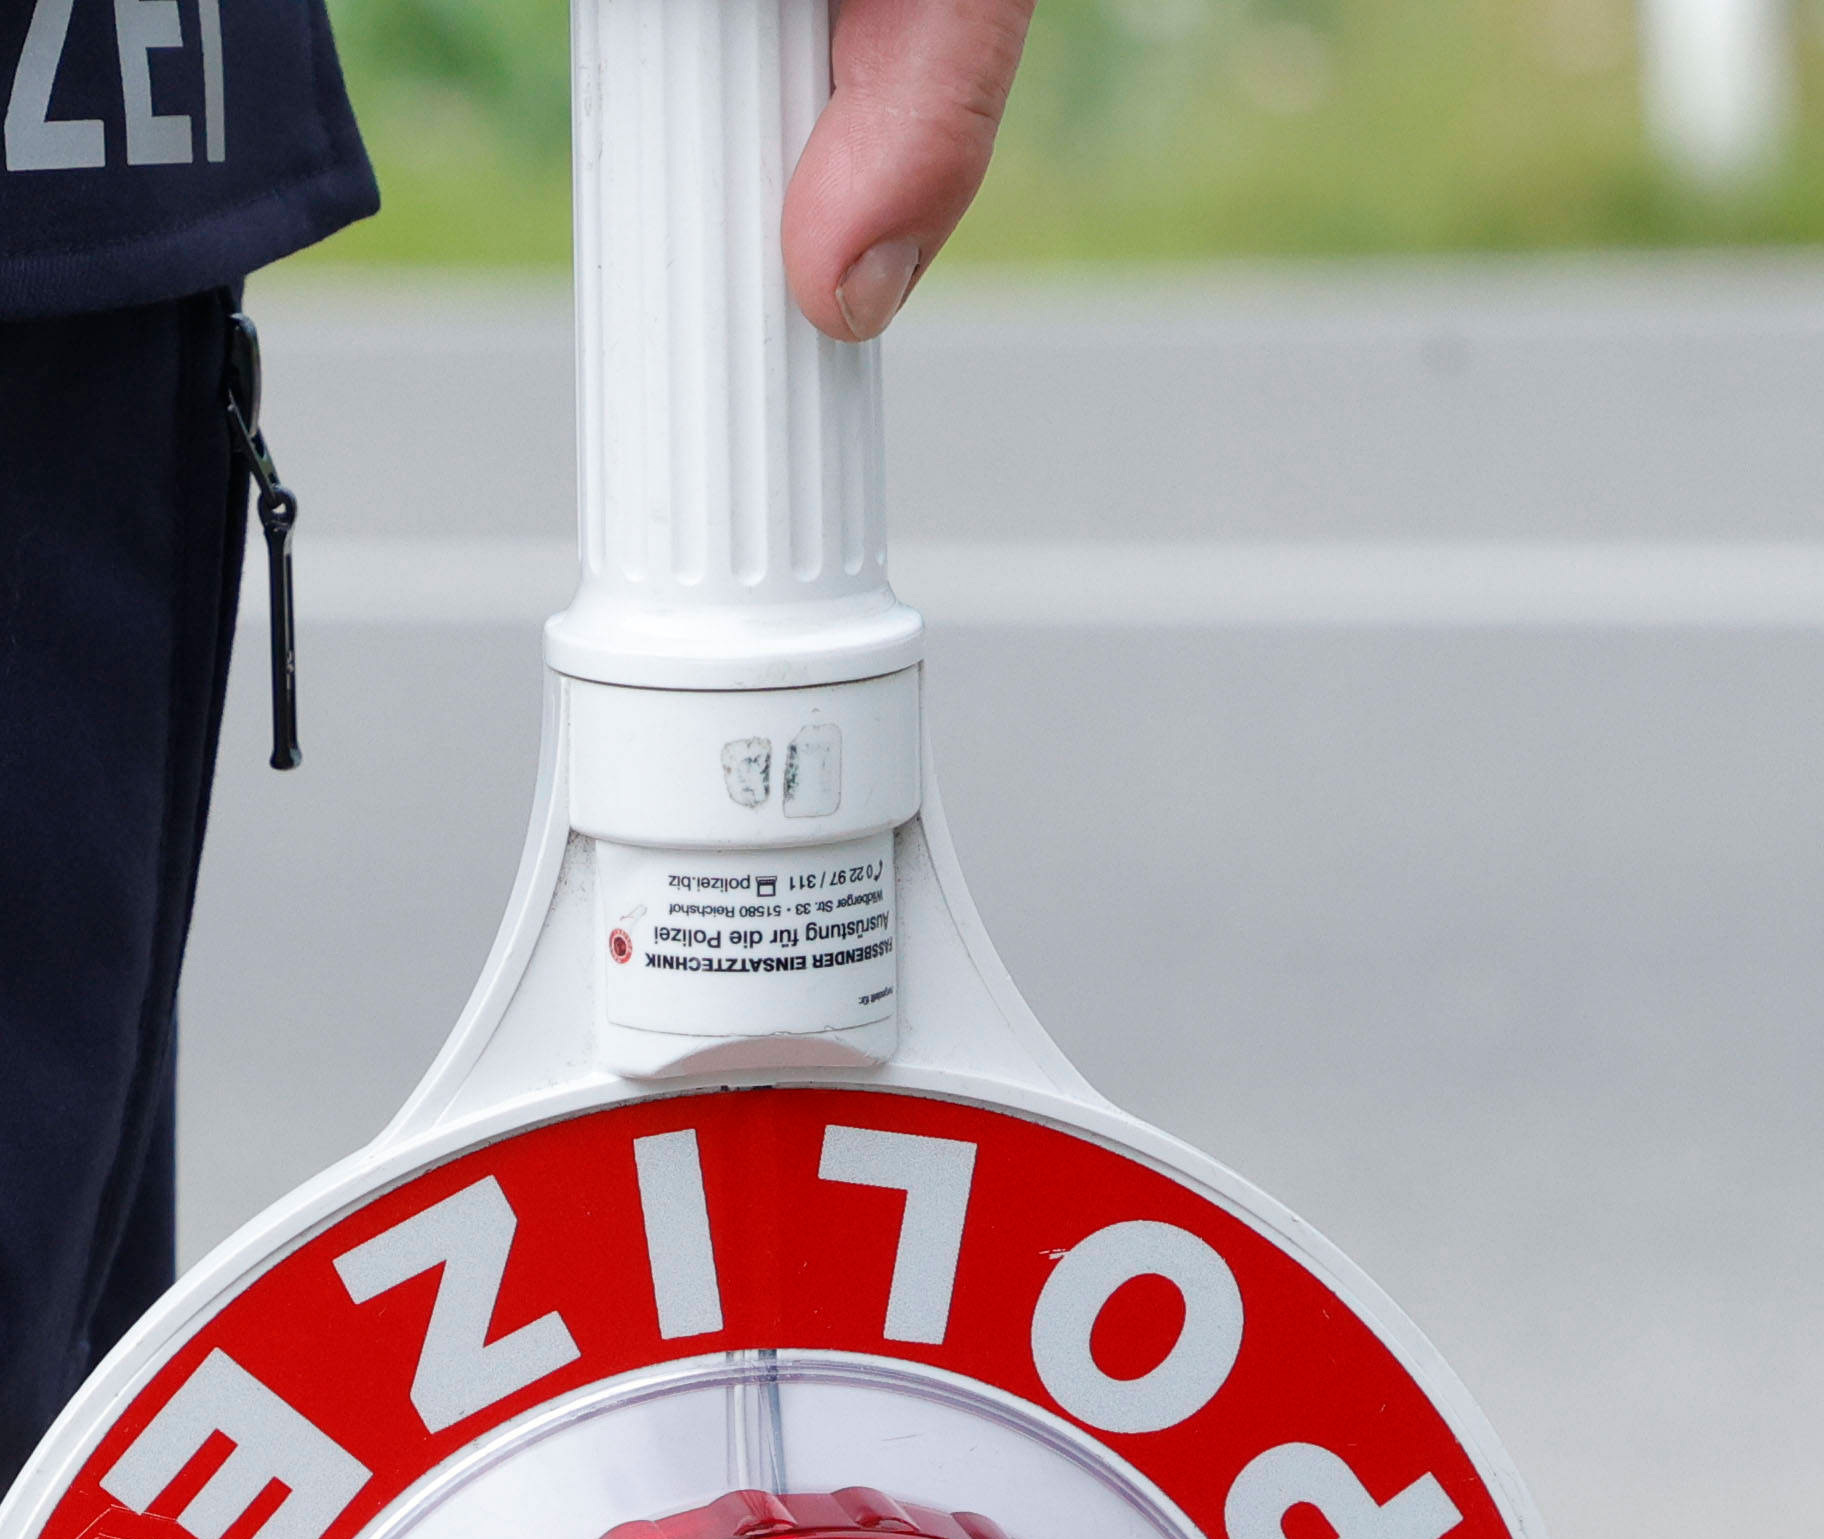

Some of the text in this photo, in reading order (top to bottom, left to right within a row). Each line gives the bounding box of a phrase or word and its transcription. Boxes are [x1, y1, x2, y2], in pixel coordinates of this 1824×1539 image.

[668, 875, 750, 892] polizei.biz
[789, 874, 816, 890] 311
[830, 870, 846, 886] 97
[669, 904, 735, 917] Reichshof
[739, 905, 782, 917] 51580
[796, 903, 811, 915] 33
[815, 900, 833, 912] Str.
[806, 911, 889, 942] Ausrüstung
[654, 927, 721, 948] Polizei
[730, 931, 762, 948] die
[770, 929, 798, 948] für
[645, 937, 893, 972] FASSBENDER EINSATZTECHNIK
